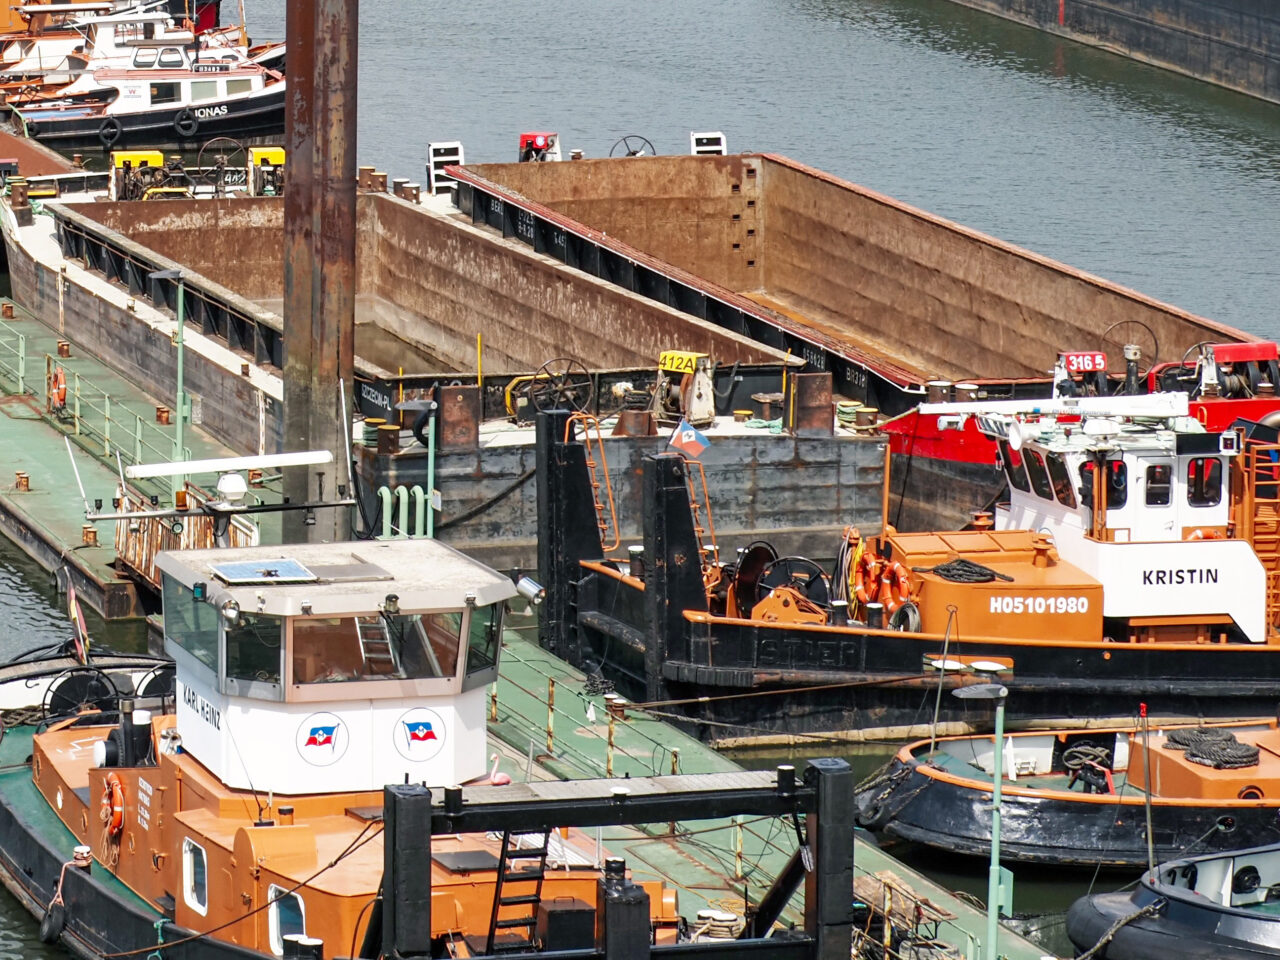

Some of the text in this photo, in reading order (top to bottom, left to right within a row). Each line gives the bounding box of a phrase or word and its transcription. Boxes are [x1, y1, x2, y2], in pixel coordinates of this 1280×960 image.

[660, 355, 694, 371] 412A
[1069, 355, 1105, 370] 316 5
[1142, 568, 1218, 585] KRISTIN
[989, 597, 1089, 614] H05101980
[183, 683, 221, 731] KARL HEINZ
